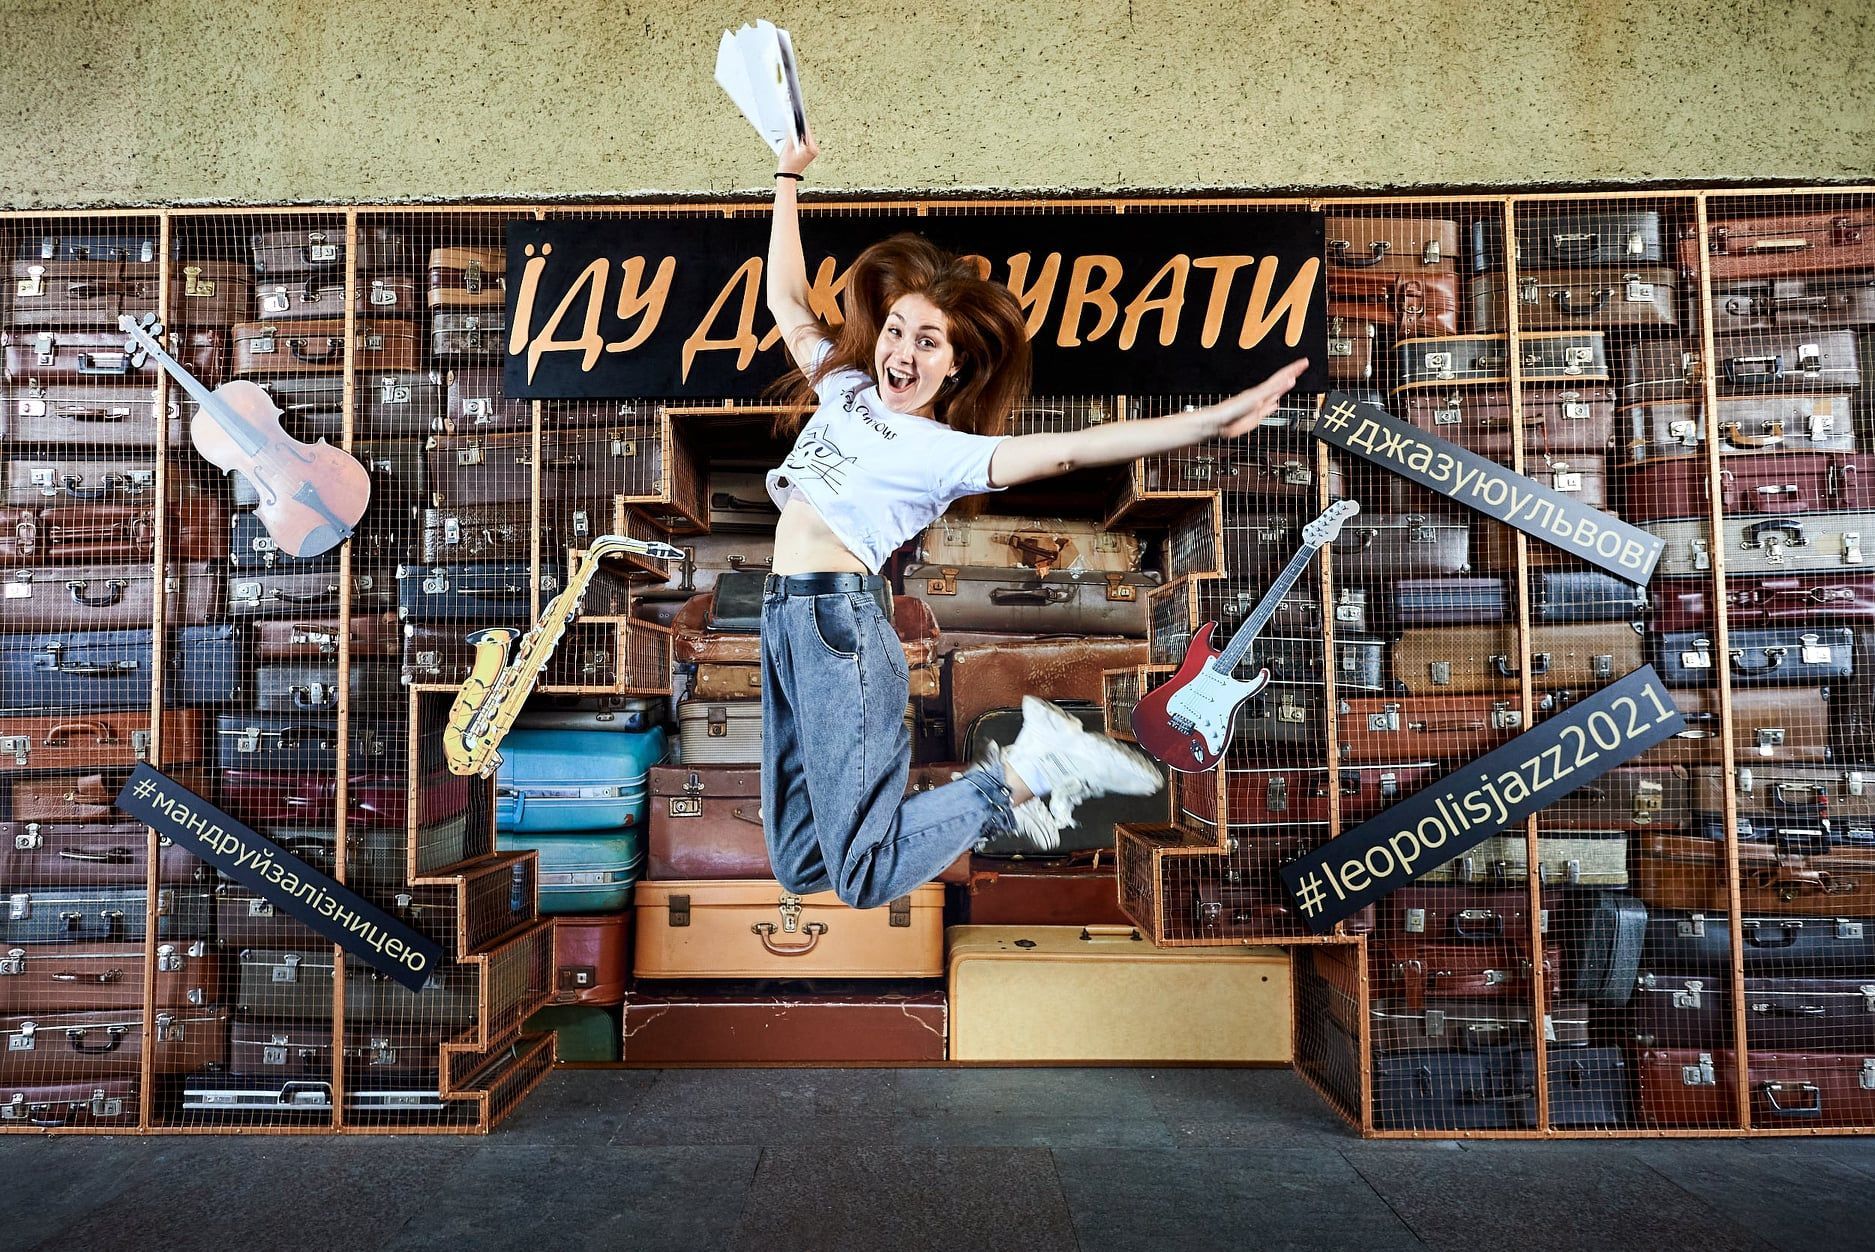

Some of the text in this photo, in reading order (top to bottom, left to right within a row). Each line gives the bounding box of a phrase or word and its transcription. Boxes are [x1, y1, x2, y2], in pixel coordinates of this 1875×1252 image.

[509, 243, 676, 385] ЇДУ
[1323, 400, 1664, 575] #джазуюульвові
[132, 778, 427, 972] #мандруйзалізницею
[1296, 683, 1675, 918] #leopolisjazz2021
